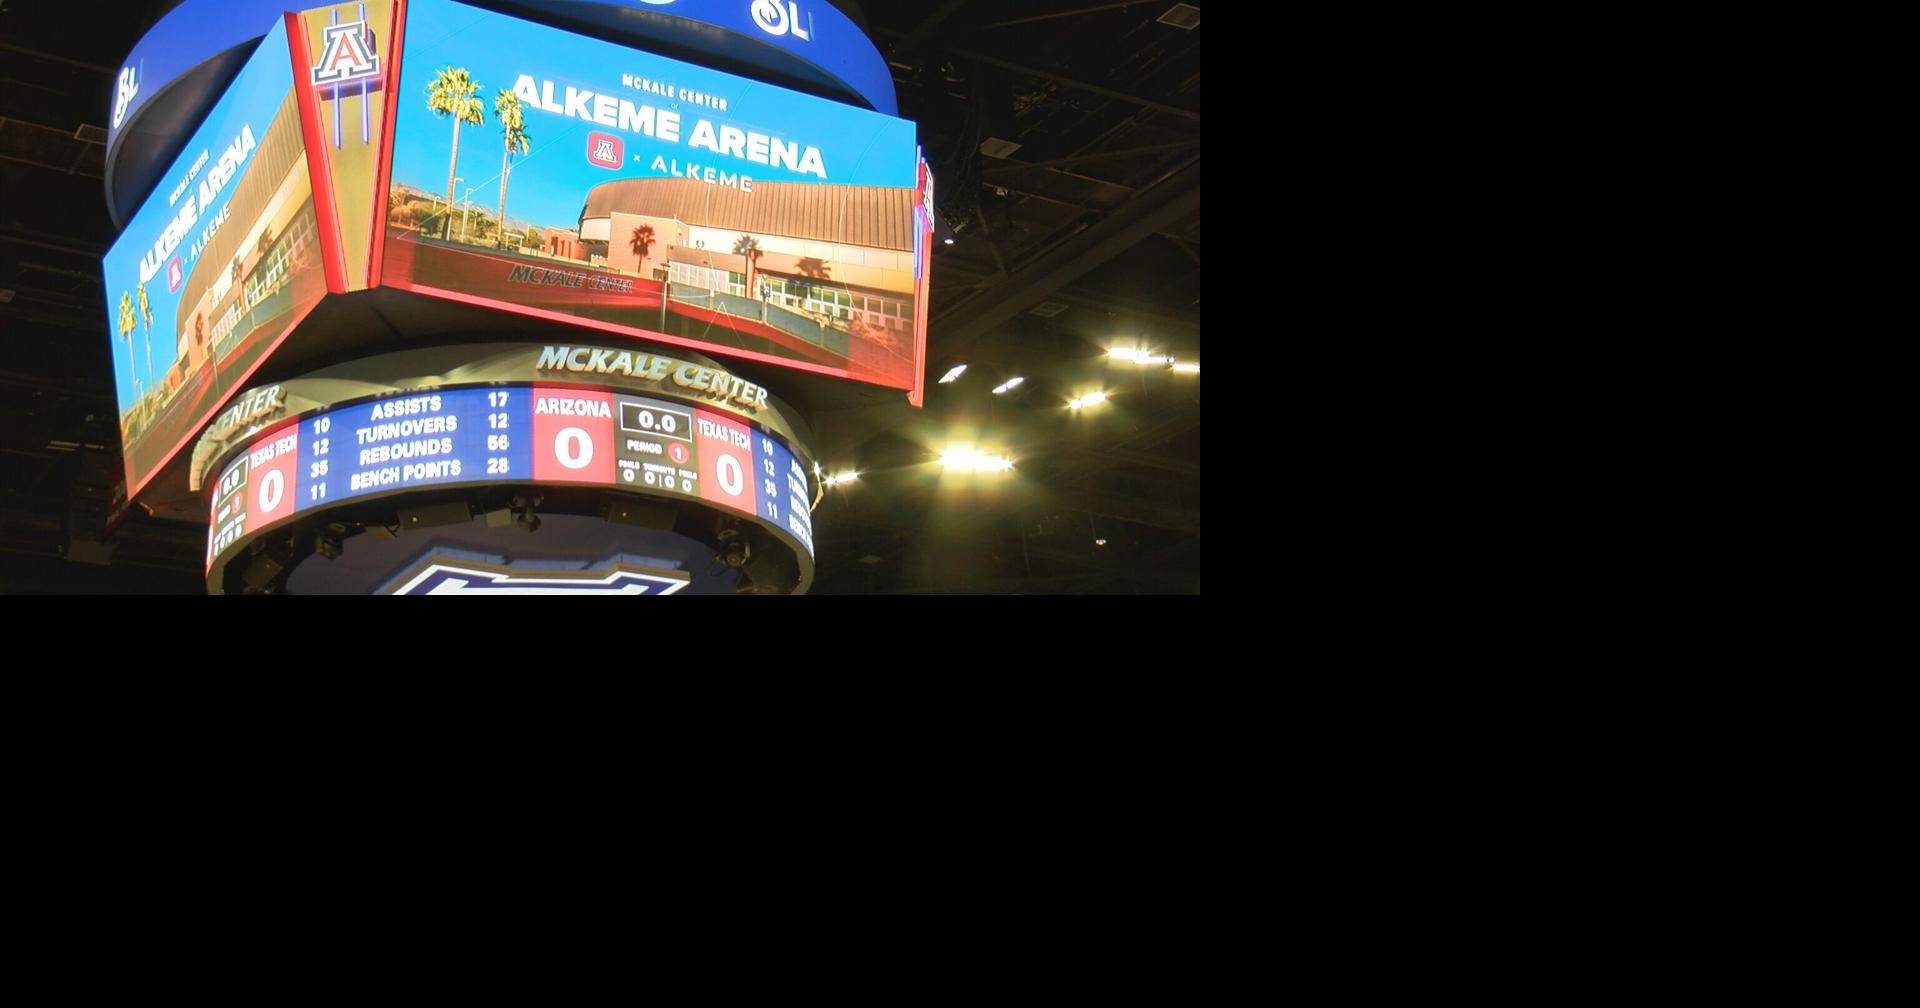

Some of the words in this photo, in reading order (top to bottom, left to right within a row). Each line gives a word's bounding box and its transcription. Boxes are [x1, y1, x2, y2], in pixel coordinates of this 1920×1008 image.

[311, 20, 380, 86] A
[621, 73, 675, 98] MCKALE
[678, 88, 729, 112] CENTER
[511, 73, 681, 143] ALKEME
[687, 119, 828, 180] ARENA
[650, 154, 753, 193] ALKEME
[139, 194, 199, 283] ALKEME
[198, 124, 257, 216] ARENA
[190, 203, 231, 262] ALKEME
[508, 263, 588, 288] MCKALE
[536, 345, 671, 381] MCKALE
[672, 361, 769, 412] CENTER
[371, 395, 442, 421] ASSISTS
[488, 391, 510, 408] 17
[534, 397, 612, 419] ARIZONA
[638, 410, 676, 433] 0.0
[313, 416, 331, 435] 10
[356, 414, 458, 444] TURNOVERS
[488, 412, 510, 429] 12
[697, 417, 729, 443] TEXAS
[729, 427, 751, 452] TECH
[250, 442, 275, 470] TEXAS
[312, 437, 330, 456] 12
[359, 436, 453, 466] REBOUNDS
[554, 426, 594, 470] 0
[626, 439, 663, 455] PERIOD
[674, 447, 682, 460] 1
[310, 458, 329, 479] 35
[350, 470, 399, 491] BENCH
[403, 458, 462, 481] POINTS
[715, 453, 744, 497] 0
[763, 459, 775, 478] 12
[258, 468, 285, 513] 0
[310, 481, 327, 501] 11
[767, 501, 778, 520] 11
